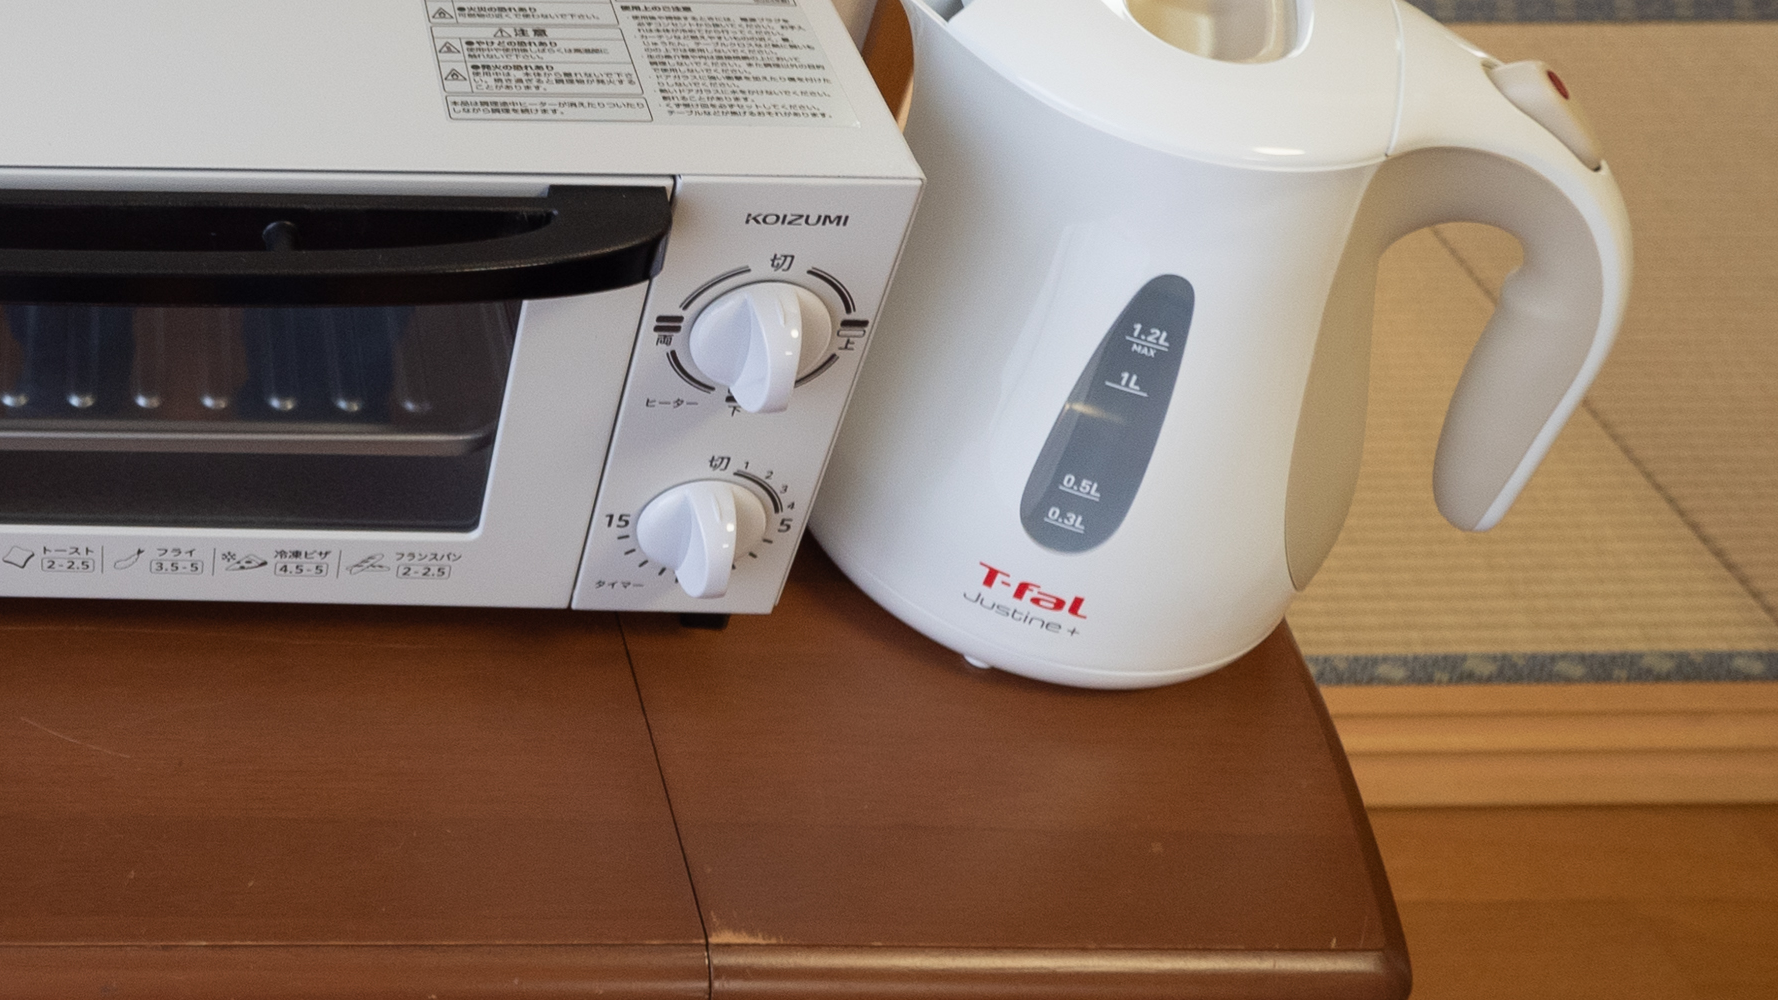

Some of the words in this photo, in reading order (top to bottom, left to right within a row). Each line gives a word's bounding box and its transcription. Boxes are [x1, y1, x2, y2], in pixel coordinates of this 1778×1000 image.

[744, 213, 850, 227] KOIZUMI
[770, 254, 795, 271] 切
[1132, 323, 1171, 347] 1.2L
[838, 339, 856, 351] 上
[1131, 343, 1156, 358] MAX
[1120, 372, 1141, 391] 1L
[645, 398, 699, 408] ヒーター
[727, 406, 742, 417] 下
[708, 456, 731, 471] 切
[743, 461, 750, 470] 1
[764, 471, 774, 479] 2
[780, 485, 789, 494] 3
[1062, 474, 1102, 497] 0.5L
[786, 502, 796, 510] 4
[604, 514, 632, 528] 15
[1047, 506, 1086, 529] 0.3L
[777, 519, 793, 533] 5
[42, 546, 95, 556] トースト
[157, 548, 195, 557] フライ
[274, 549, 331, 559] 冷凍ピザ
[396, 552, 462, 562] フランスパン
[595, 580, 644, 590] タイマー
[979, 561, 1088, 619] T-fal
[962, 591, 1062, 634] Justine
